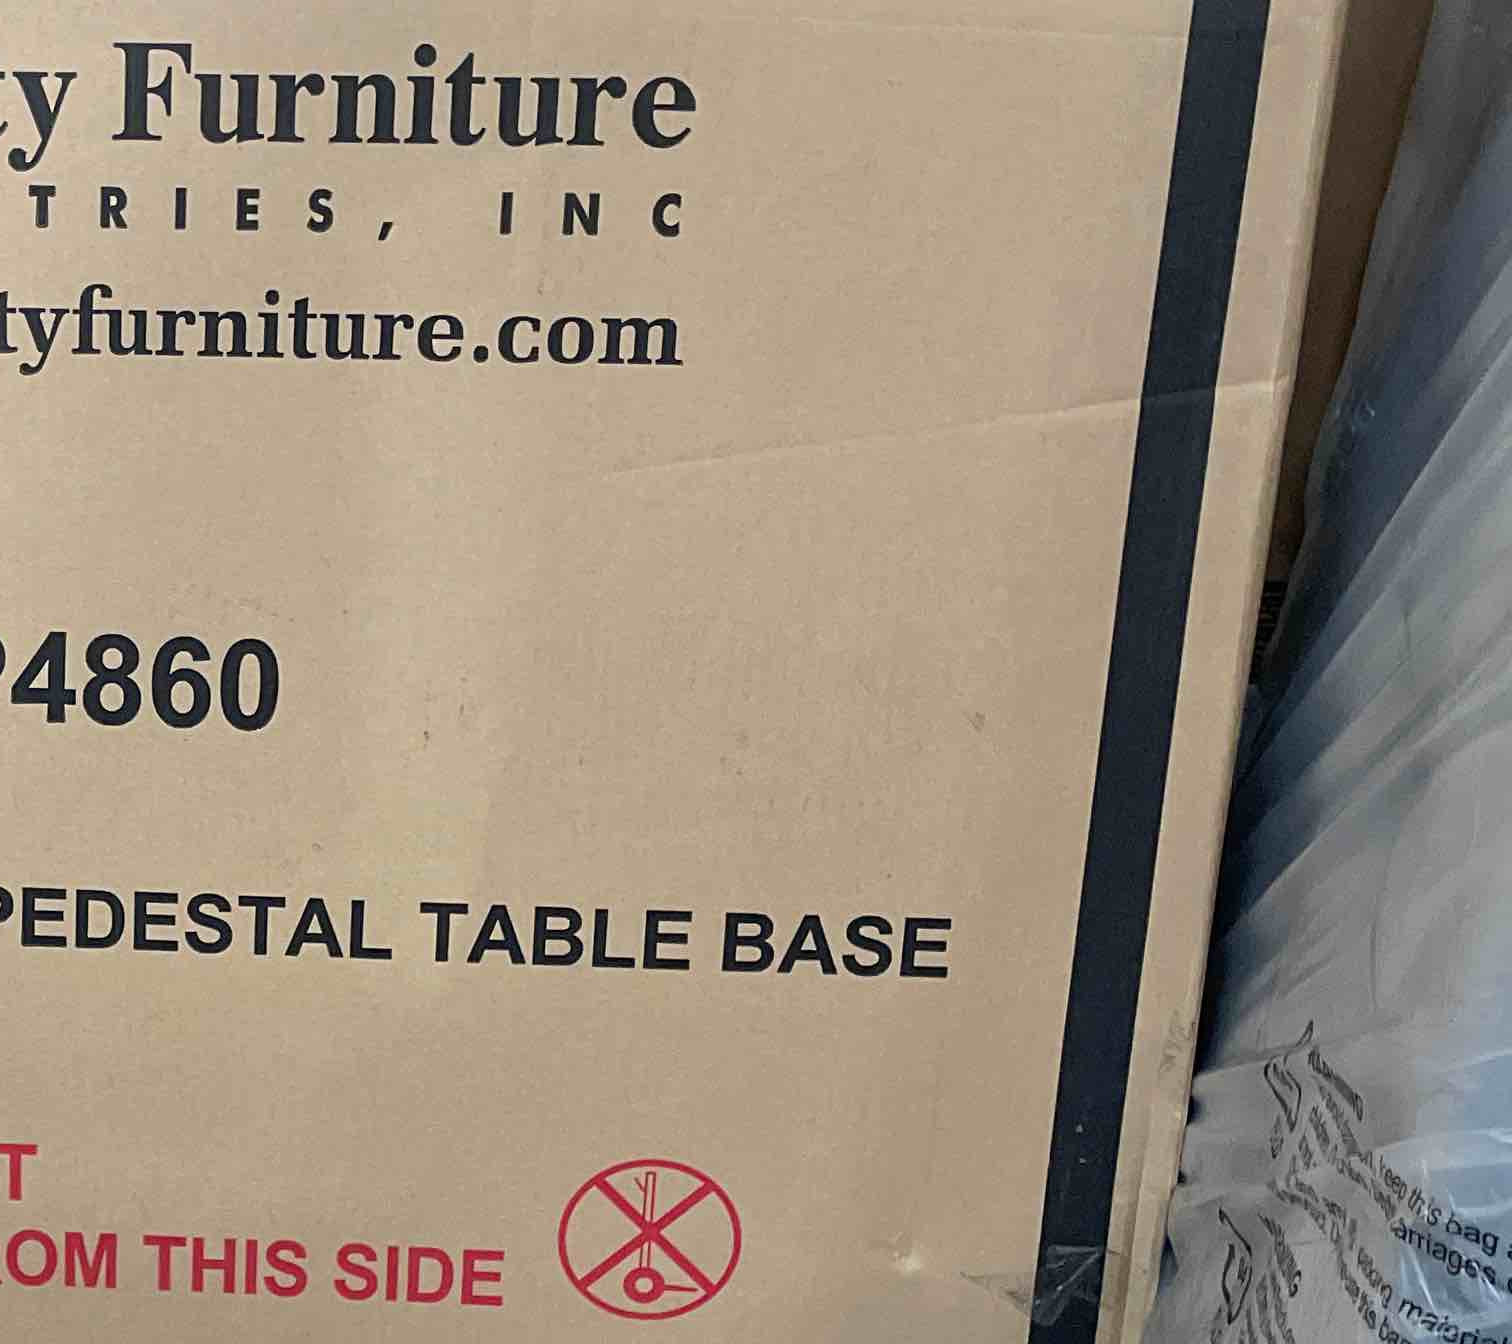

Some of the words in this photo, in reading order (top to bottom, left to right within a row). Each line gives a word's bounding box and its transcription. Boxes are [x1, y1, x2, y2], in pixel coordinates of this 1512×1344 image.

[112, 41, 697, 149] Furniture
[499, 191, 683, 238] INC
[419, 900, 694, 972] TABLE
[720, 910, 953, 979] BASE
[142, 1233, 309, 1299] THIS
[333, 1241, 506, 1308] SIDE
[1445, 1212, 1500, 1256] bag
